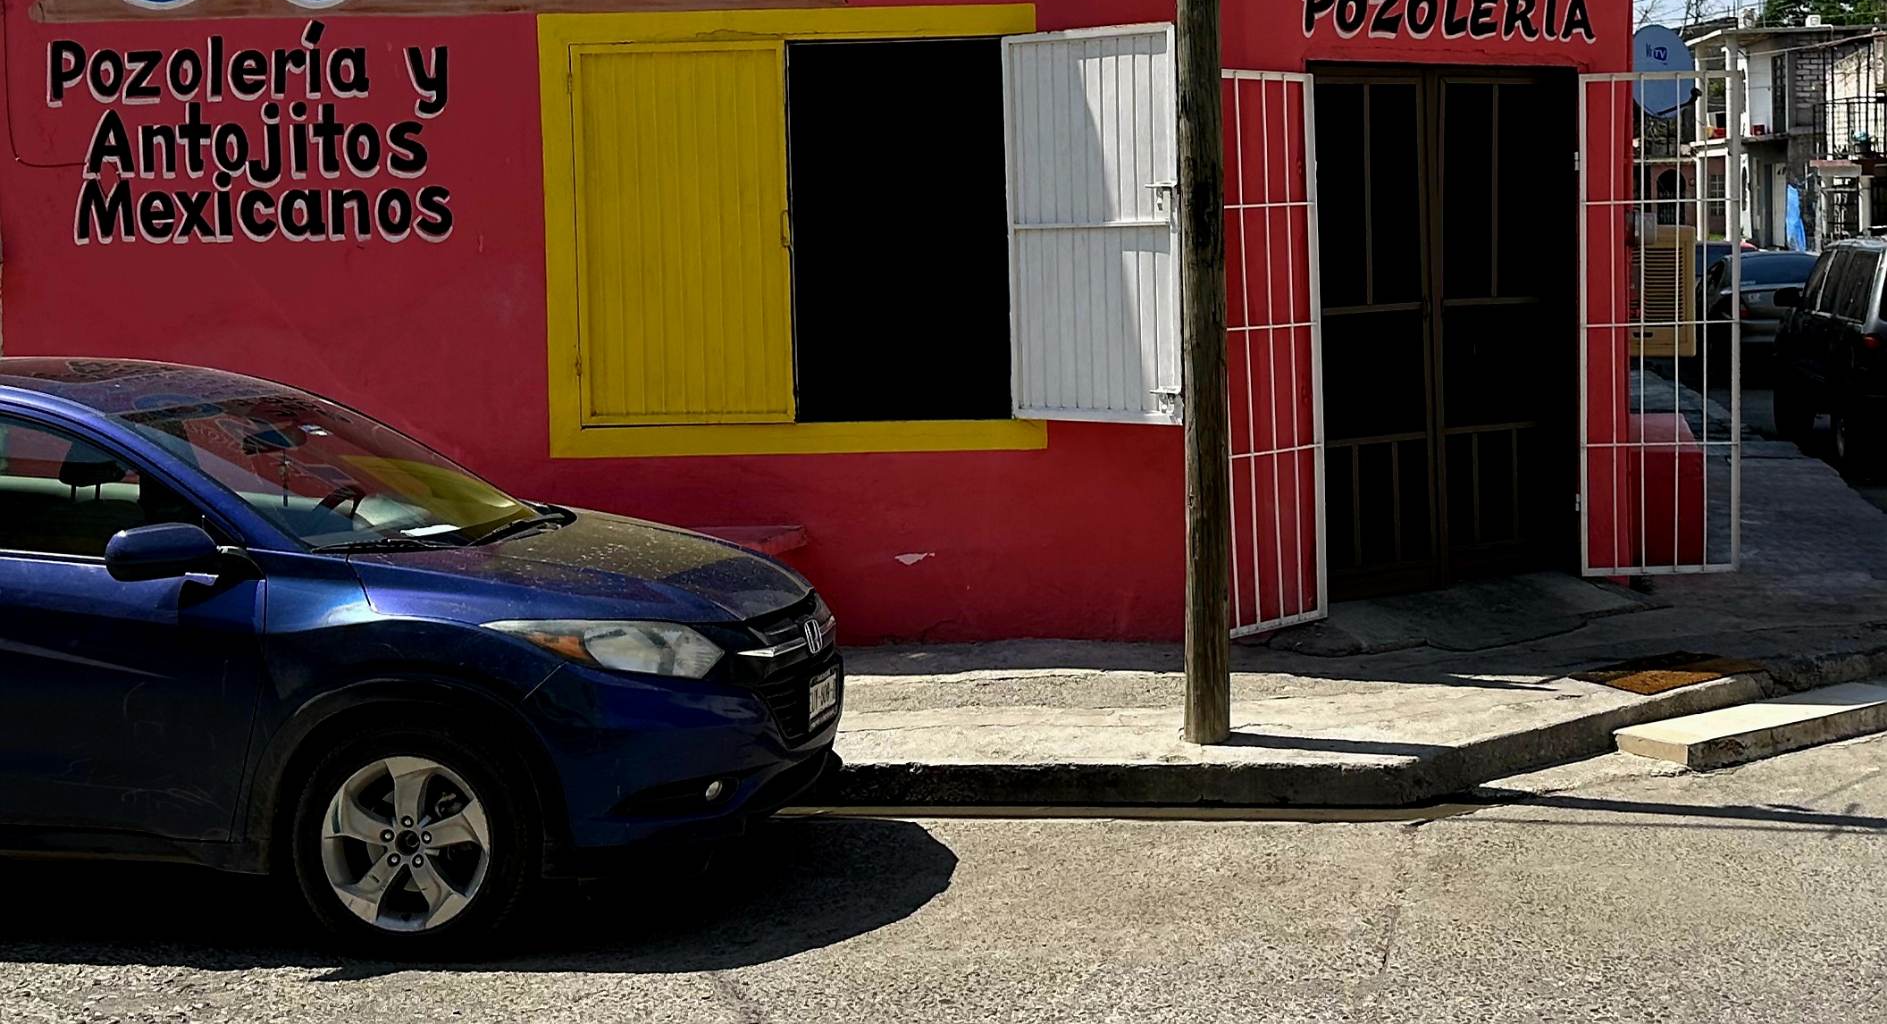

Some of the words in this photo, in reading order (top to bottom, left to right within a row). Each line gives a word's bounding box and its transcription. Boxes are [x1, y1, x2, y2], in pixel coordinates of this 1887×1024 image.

[46, 20, 370, 107] Pozolería
[403, 45, 448, 119] y
[83, 101, 428, 189] Antojitos
[74, 171, 454, 245] Mexicanos
